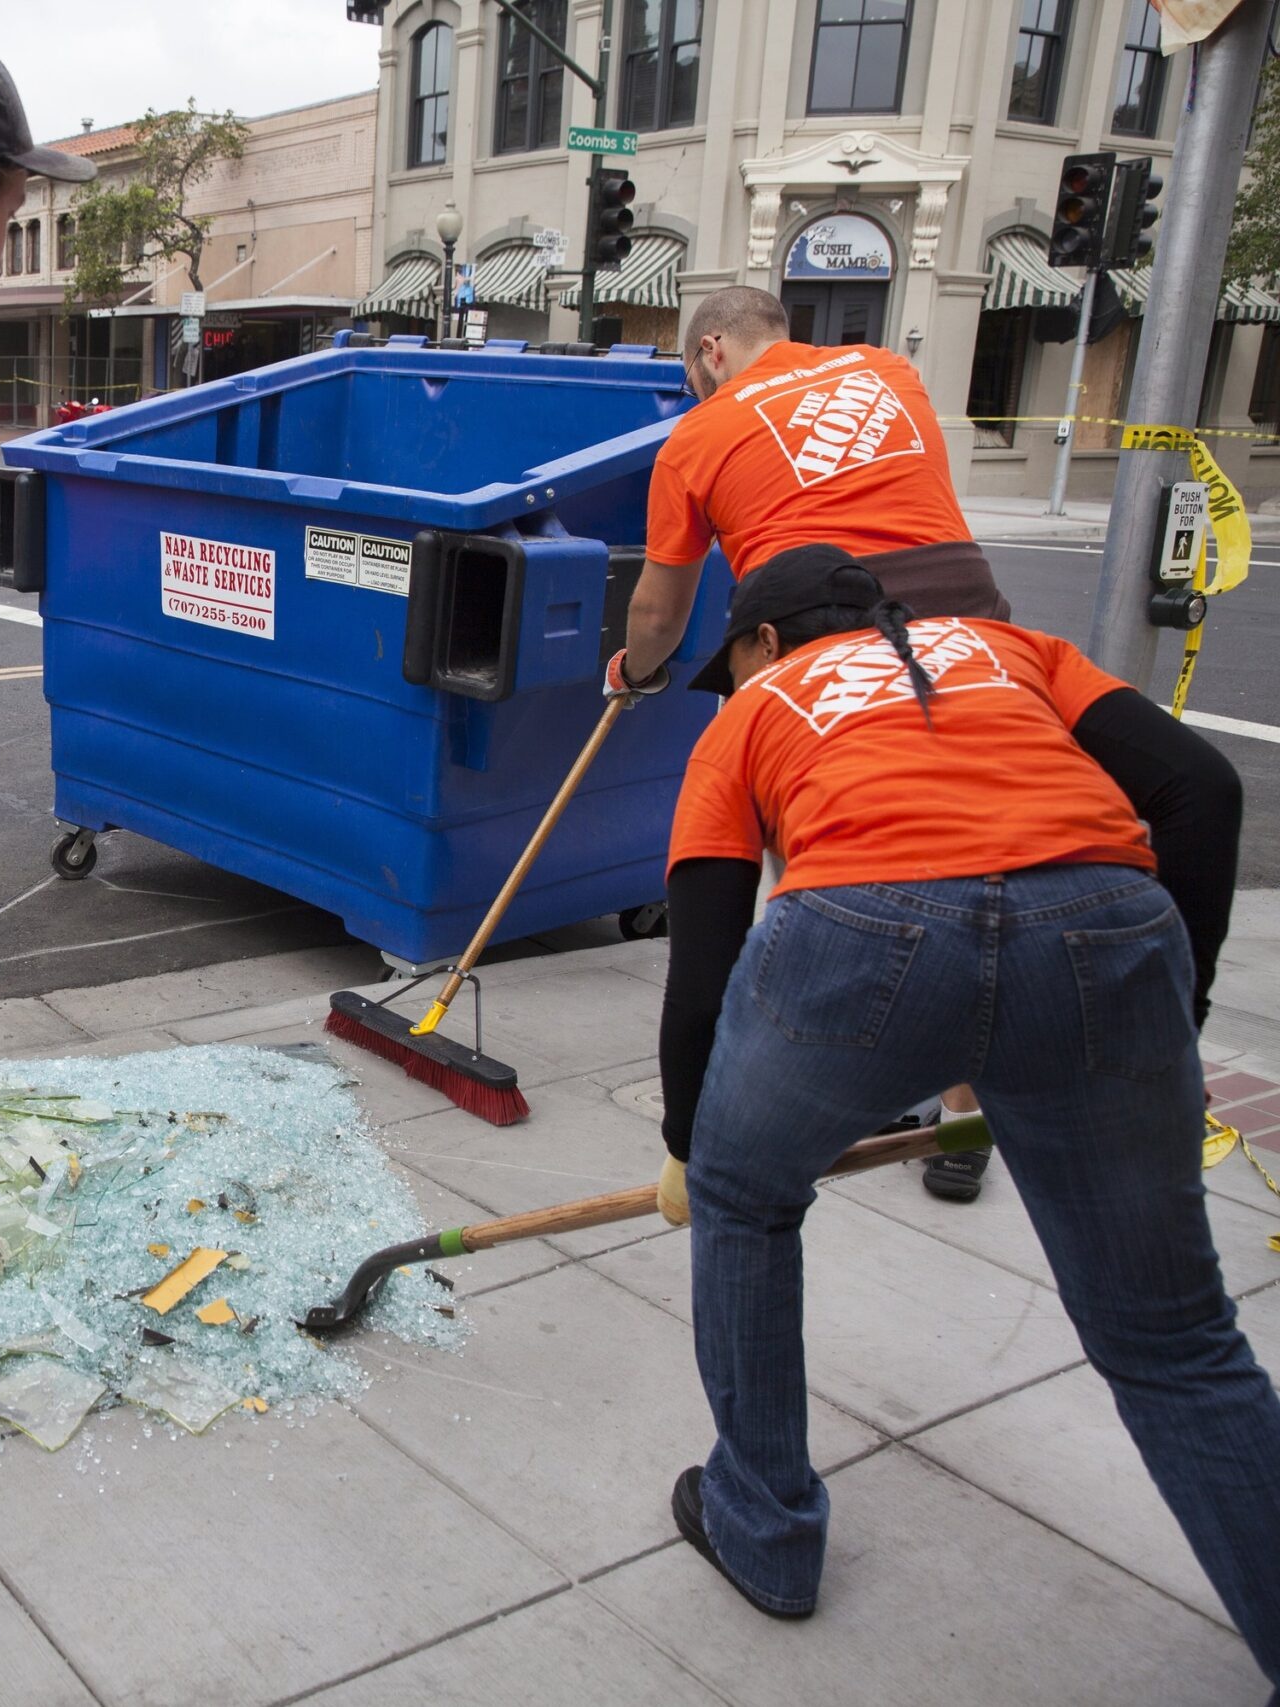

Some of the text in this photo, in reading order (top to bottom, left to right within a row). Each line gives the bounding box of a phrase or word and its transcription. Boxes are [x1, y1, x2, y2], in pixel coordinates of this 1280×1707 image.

[568, 131, 636, 151] Coombs St
[813, 244, 852, 256] SUSHI
[826, 255, 881, 271] MAMBO
[787, 391, 830, 429] THE
[793, 373, 884, 475] HOME
[848, 392, 906, 462] DEPOT
[1180, 492, 1201, 502] PUSH
[1174, 504, 1203, 514] BUTTON
[1180, 516, 1195, 526] FOR
[310, 533, 354, 552] CAUTION
[164, 535, 271, 574] NAPA RECYCLING
[363, 542, 409, 562] CAUTION
[315, 556, 331, 564] AROUND
[339, 560, 355, 568] OCCUPY
[321, 564, 343, 572] CONTAINER
[326, 571, 345, 579] PURPOSE
[215, 571, 271, 599] SERVICES
